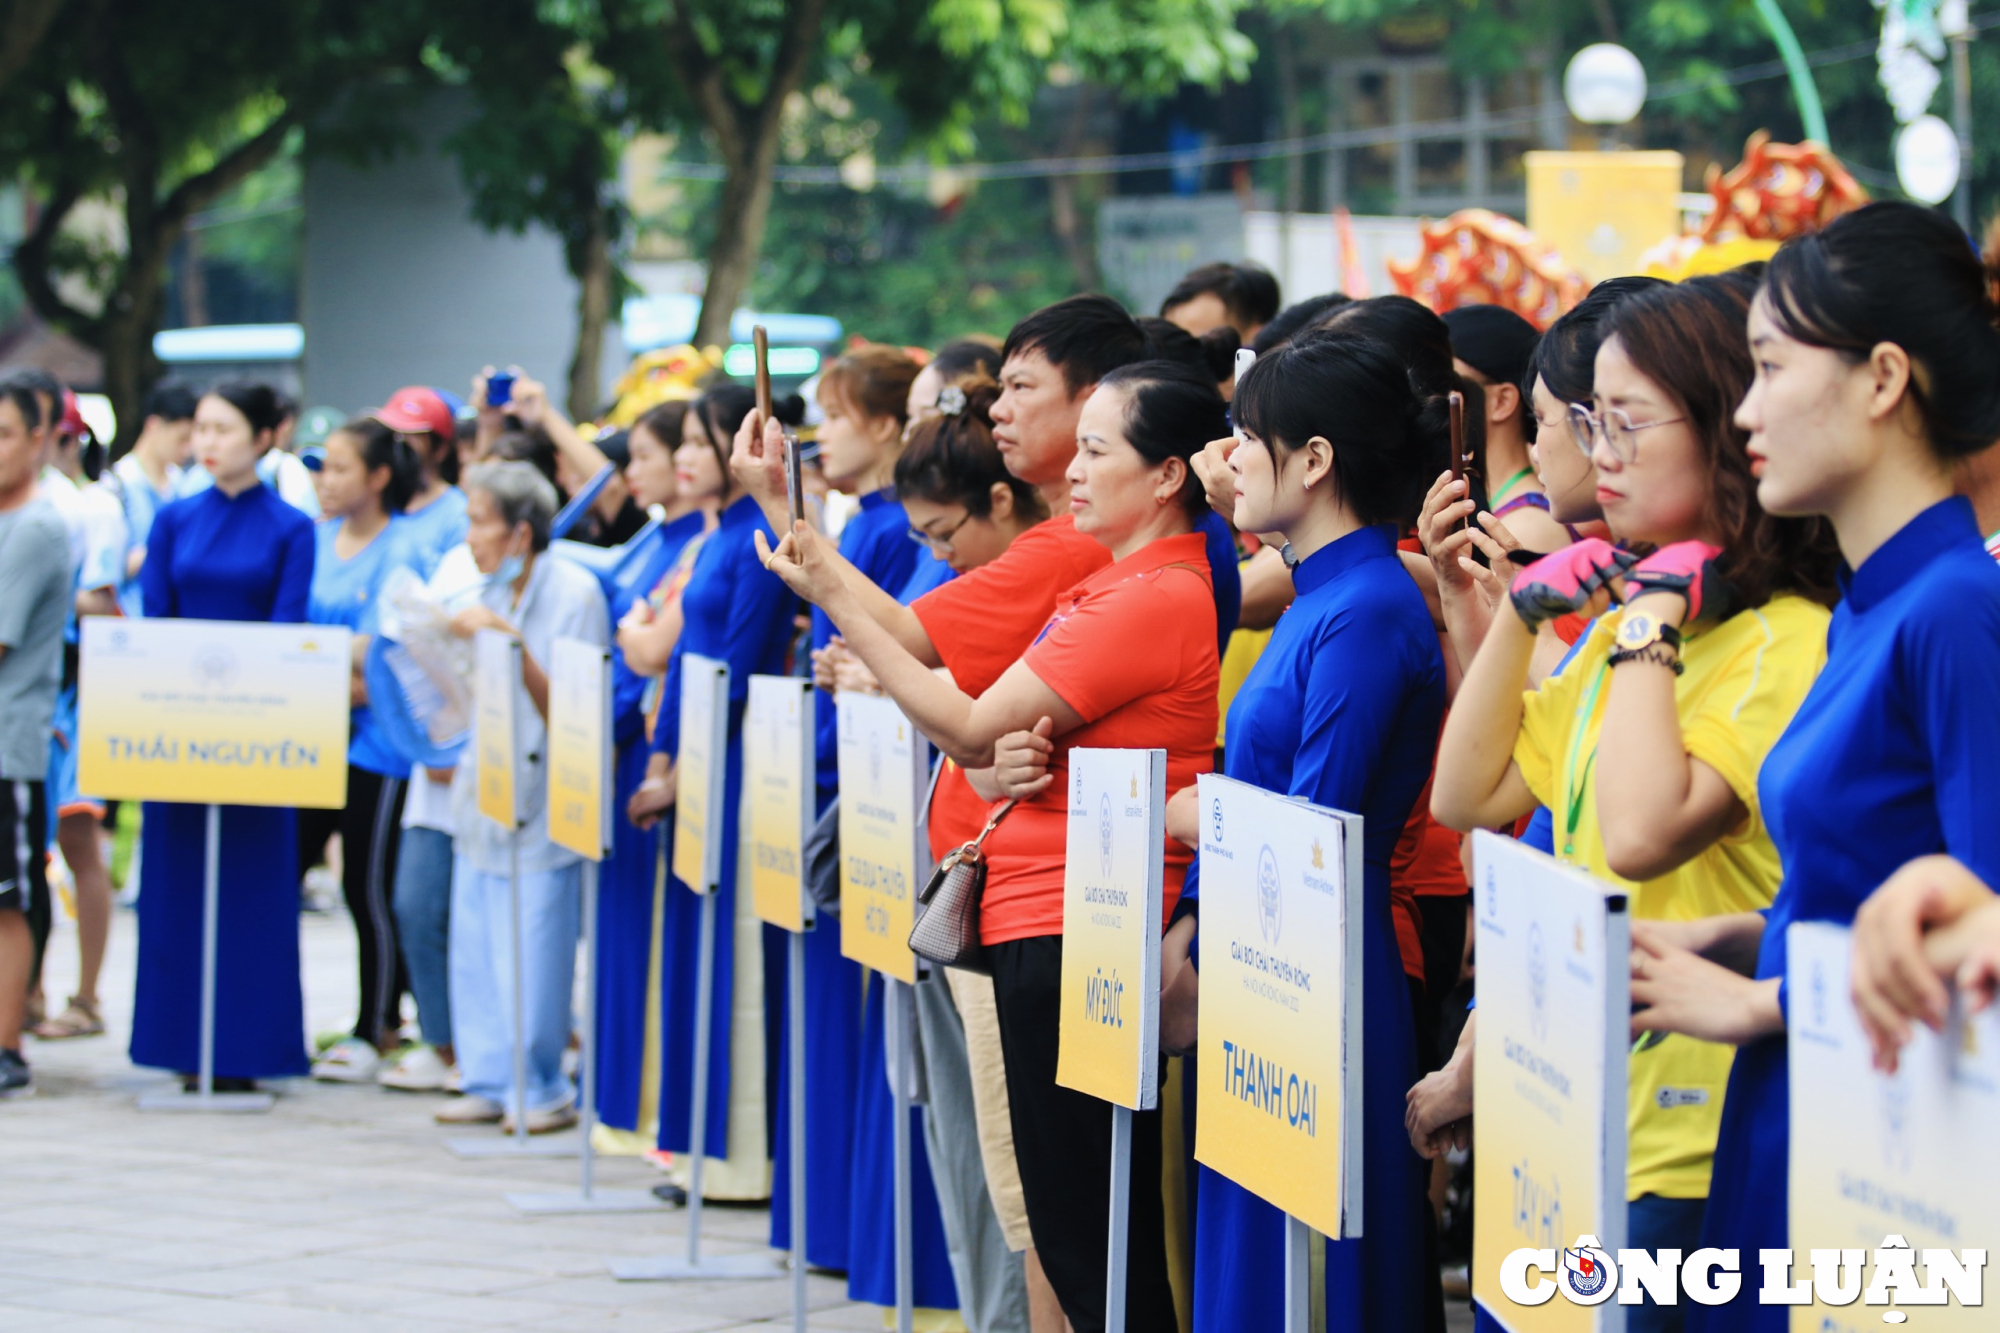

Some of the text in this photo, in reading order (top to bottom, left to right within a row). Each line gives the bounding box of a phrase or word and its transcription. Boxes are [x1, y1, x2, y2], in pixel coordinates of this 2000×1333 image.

[107, 735, 319, 768] THÁI NGUYÊN
[1231, 937, 1311, 992] GIẢI BƠI CHẢI THUYỀN RỒNG
[1085, 967, 1124, 1028] MỸ ĐỨC
[1223, 1039, 1317, 1138] THANH OAI
[1512, 1158, 1540, 1242] TÂY
